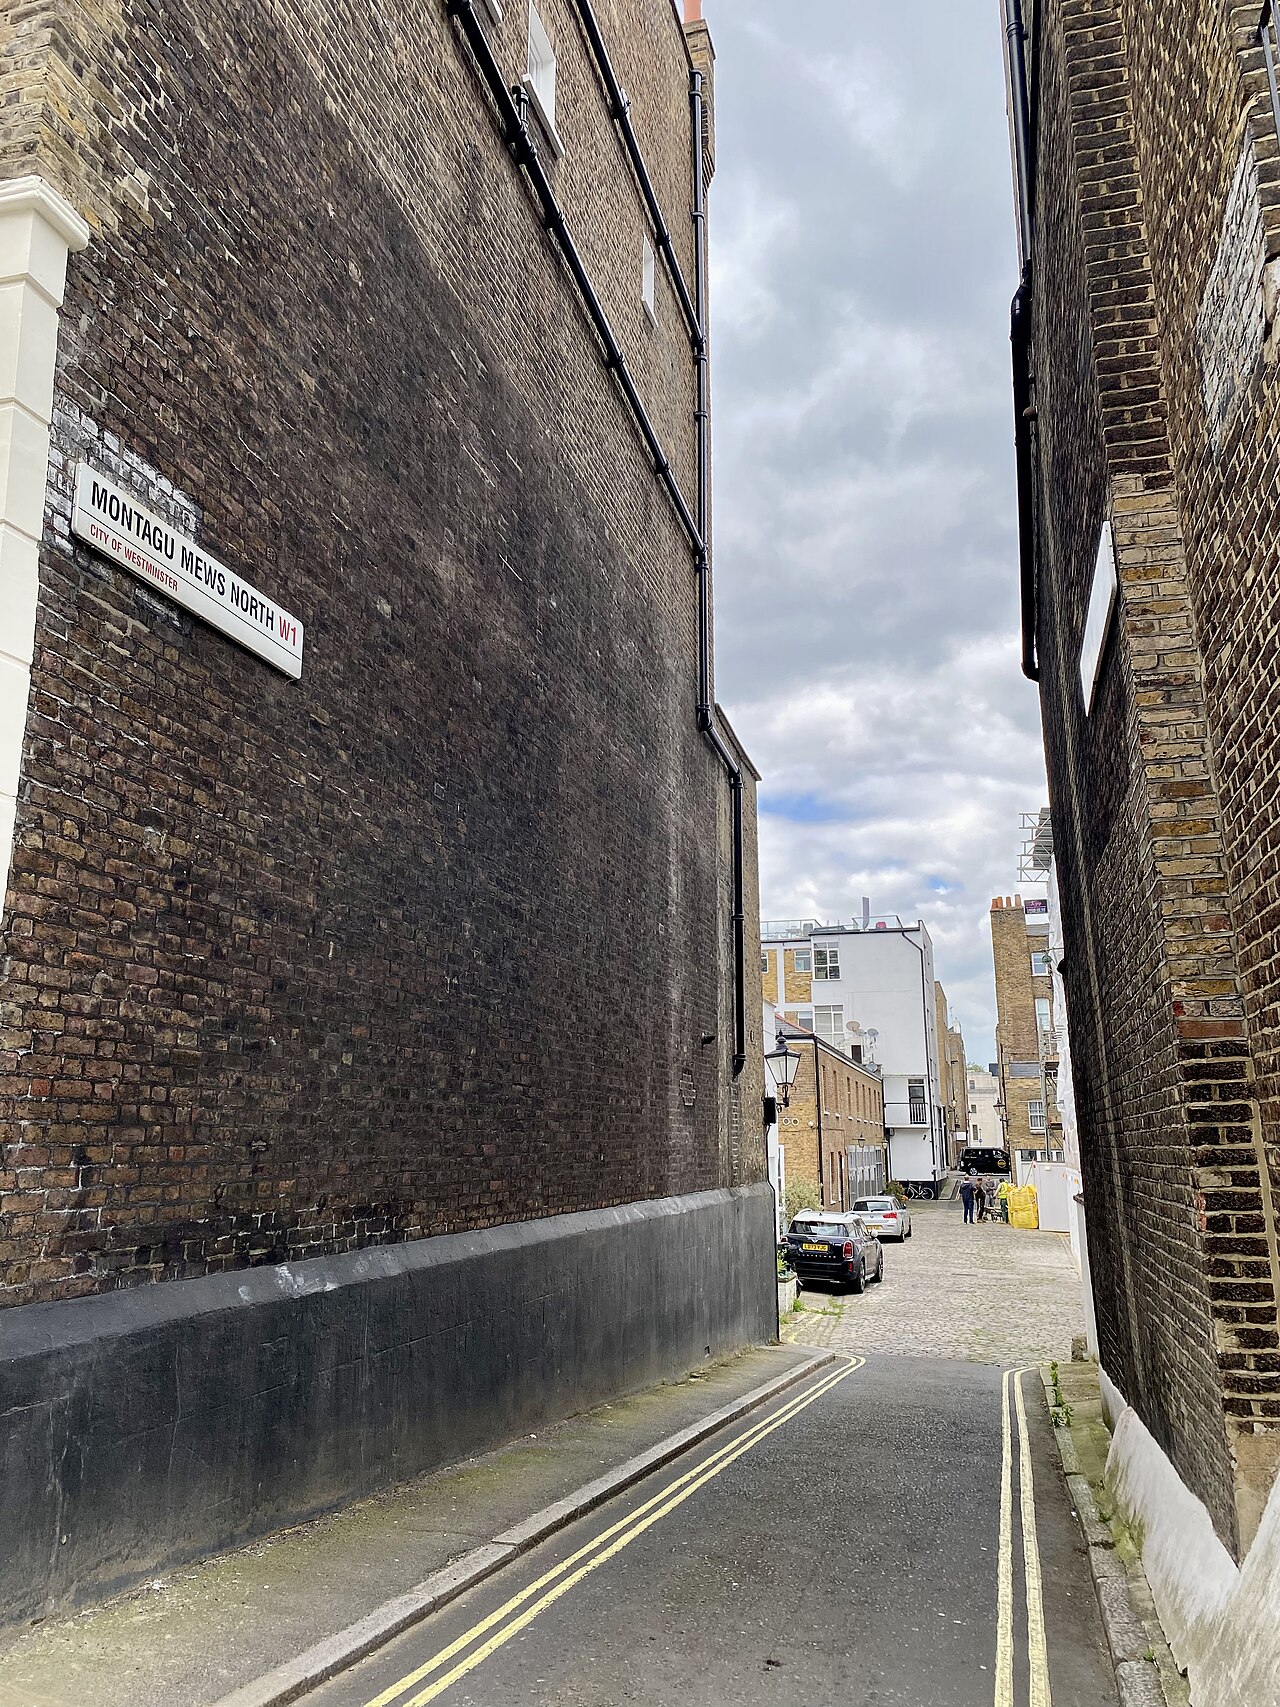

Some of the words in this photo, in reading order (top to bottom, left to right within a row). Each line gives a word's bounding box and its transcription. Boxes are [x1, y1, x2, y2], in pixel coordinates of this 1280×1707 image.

[90, 524, 109, 545] CITY
[111, 538, 122, 553] OF
[124, 546, 178, 592] WESTMINSTER
[91, 481, 175, 560] MONTAGU
[180, 546, 226, 596] MEWS
[231, 581, 274, 631] NORTH
[278, 616, 297, 647] W1
